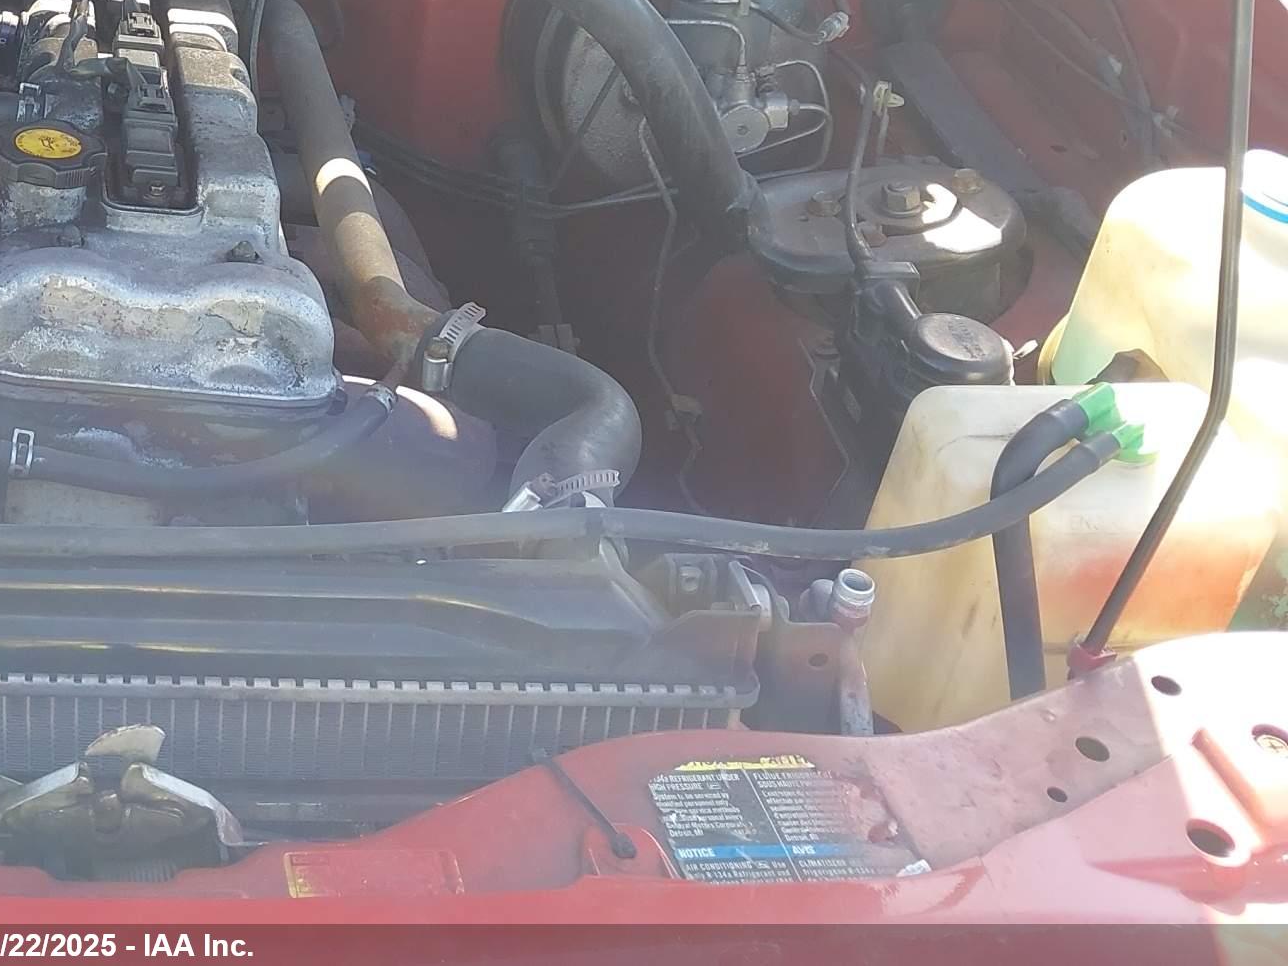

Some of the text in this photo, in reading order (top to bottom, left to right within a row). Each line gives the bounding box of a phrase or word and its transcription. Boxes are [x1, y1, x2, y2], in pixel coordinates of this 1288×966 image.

[669, 773, 716, 783] REFRIGERANT
[666, 782, 703, 791] PRESSURE
[678, 844, 816, 858] NOTICE AVIS
[685, 859, 787, 871] AIR CONDITIONING Use
[733, 868, 776, 879] Refrigerant
[777, 869, 791, 877] and
